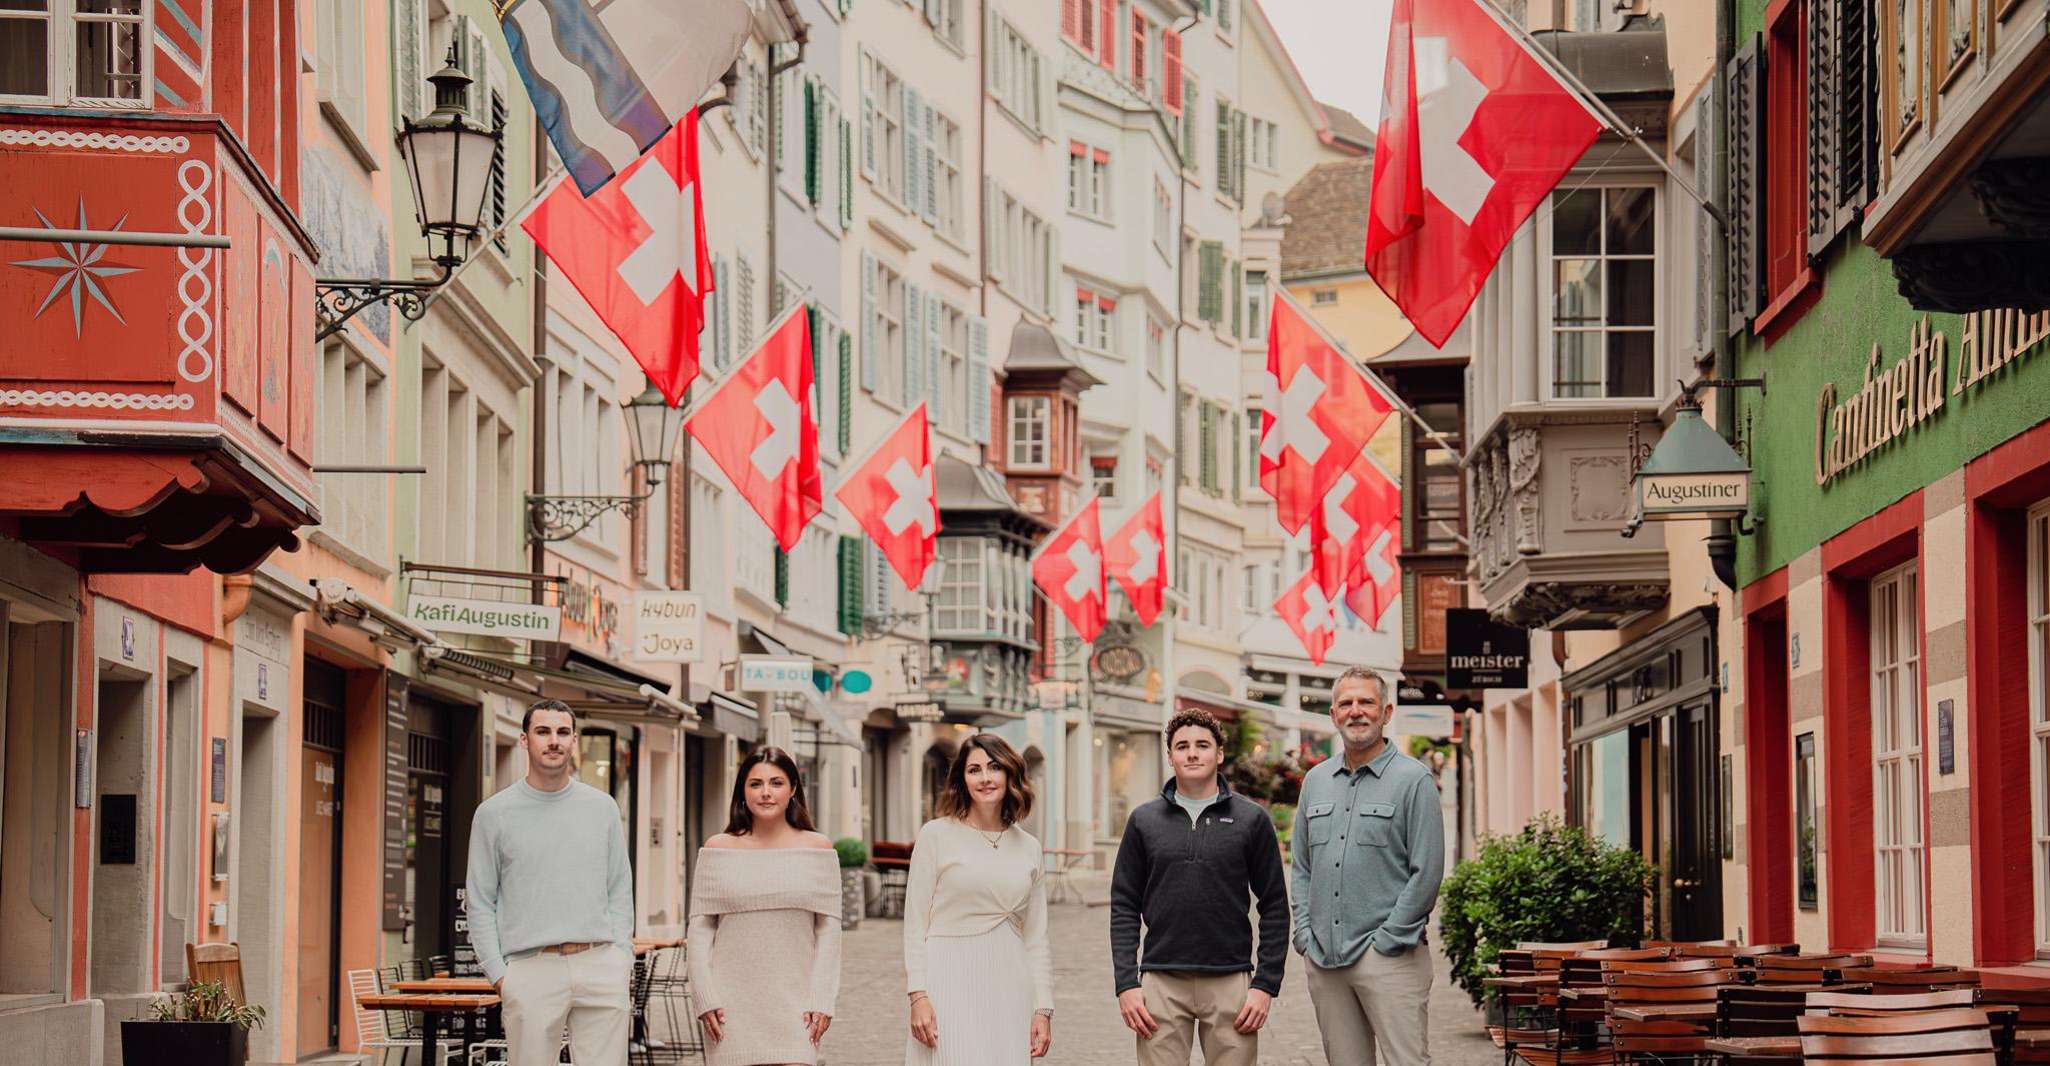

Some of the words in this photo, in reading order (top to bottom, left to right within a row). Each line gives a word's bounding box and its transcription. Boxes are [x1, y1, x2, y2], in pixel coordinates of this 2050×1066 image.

[1815, 312, 1945, 486] Cantinetta
[1647, 481, 1741, 504] Augustiner
[641, 600, 697, 618] kybun
[642, 633, 693, 656] Joya
[1451, 654, 1524, 668] meister
